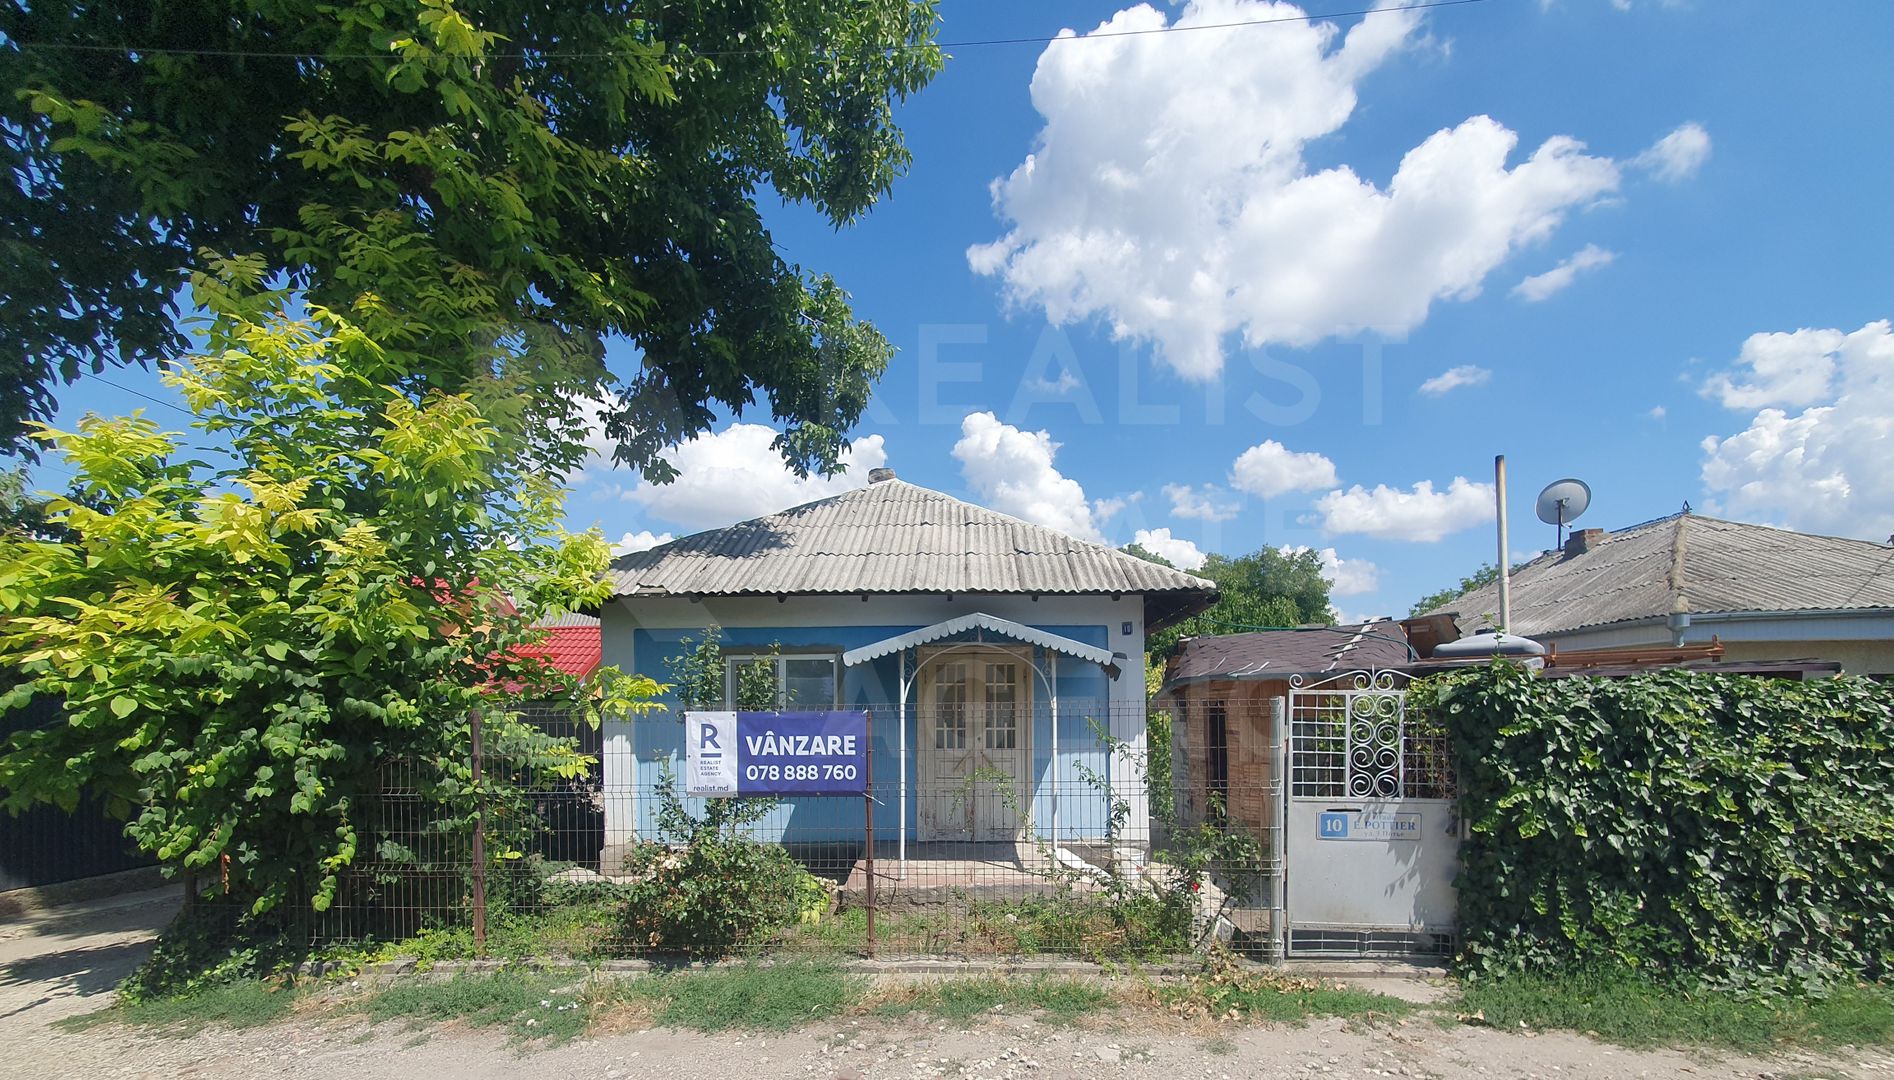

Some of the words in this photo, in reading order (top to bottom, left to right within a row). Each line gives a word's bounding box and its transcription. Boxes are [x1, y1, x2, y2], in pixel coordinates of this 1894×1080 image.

[700, 723, 721, 749] R
[746, 730, 856, 756] VÂNZARE
[746, 765, 780, 781] 078
[784, 765, 819, 780] 888
[823, 764, 857, 780] 760
[1325, 818, 1343, 832] 10
